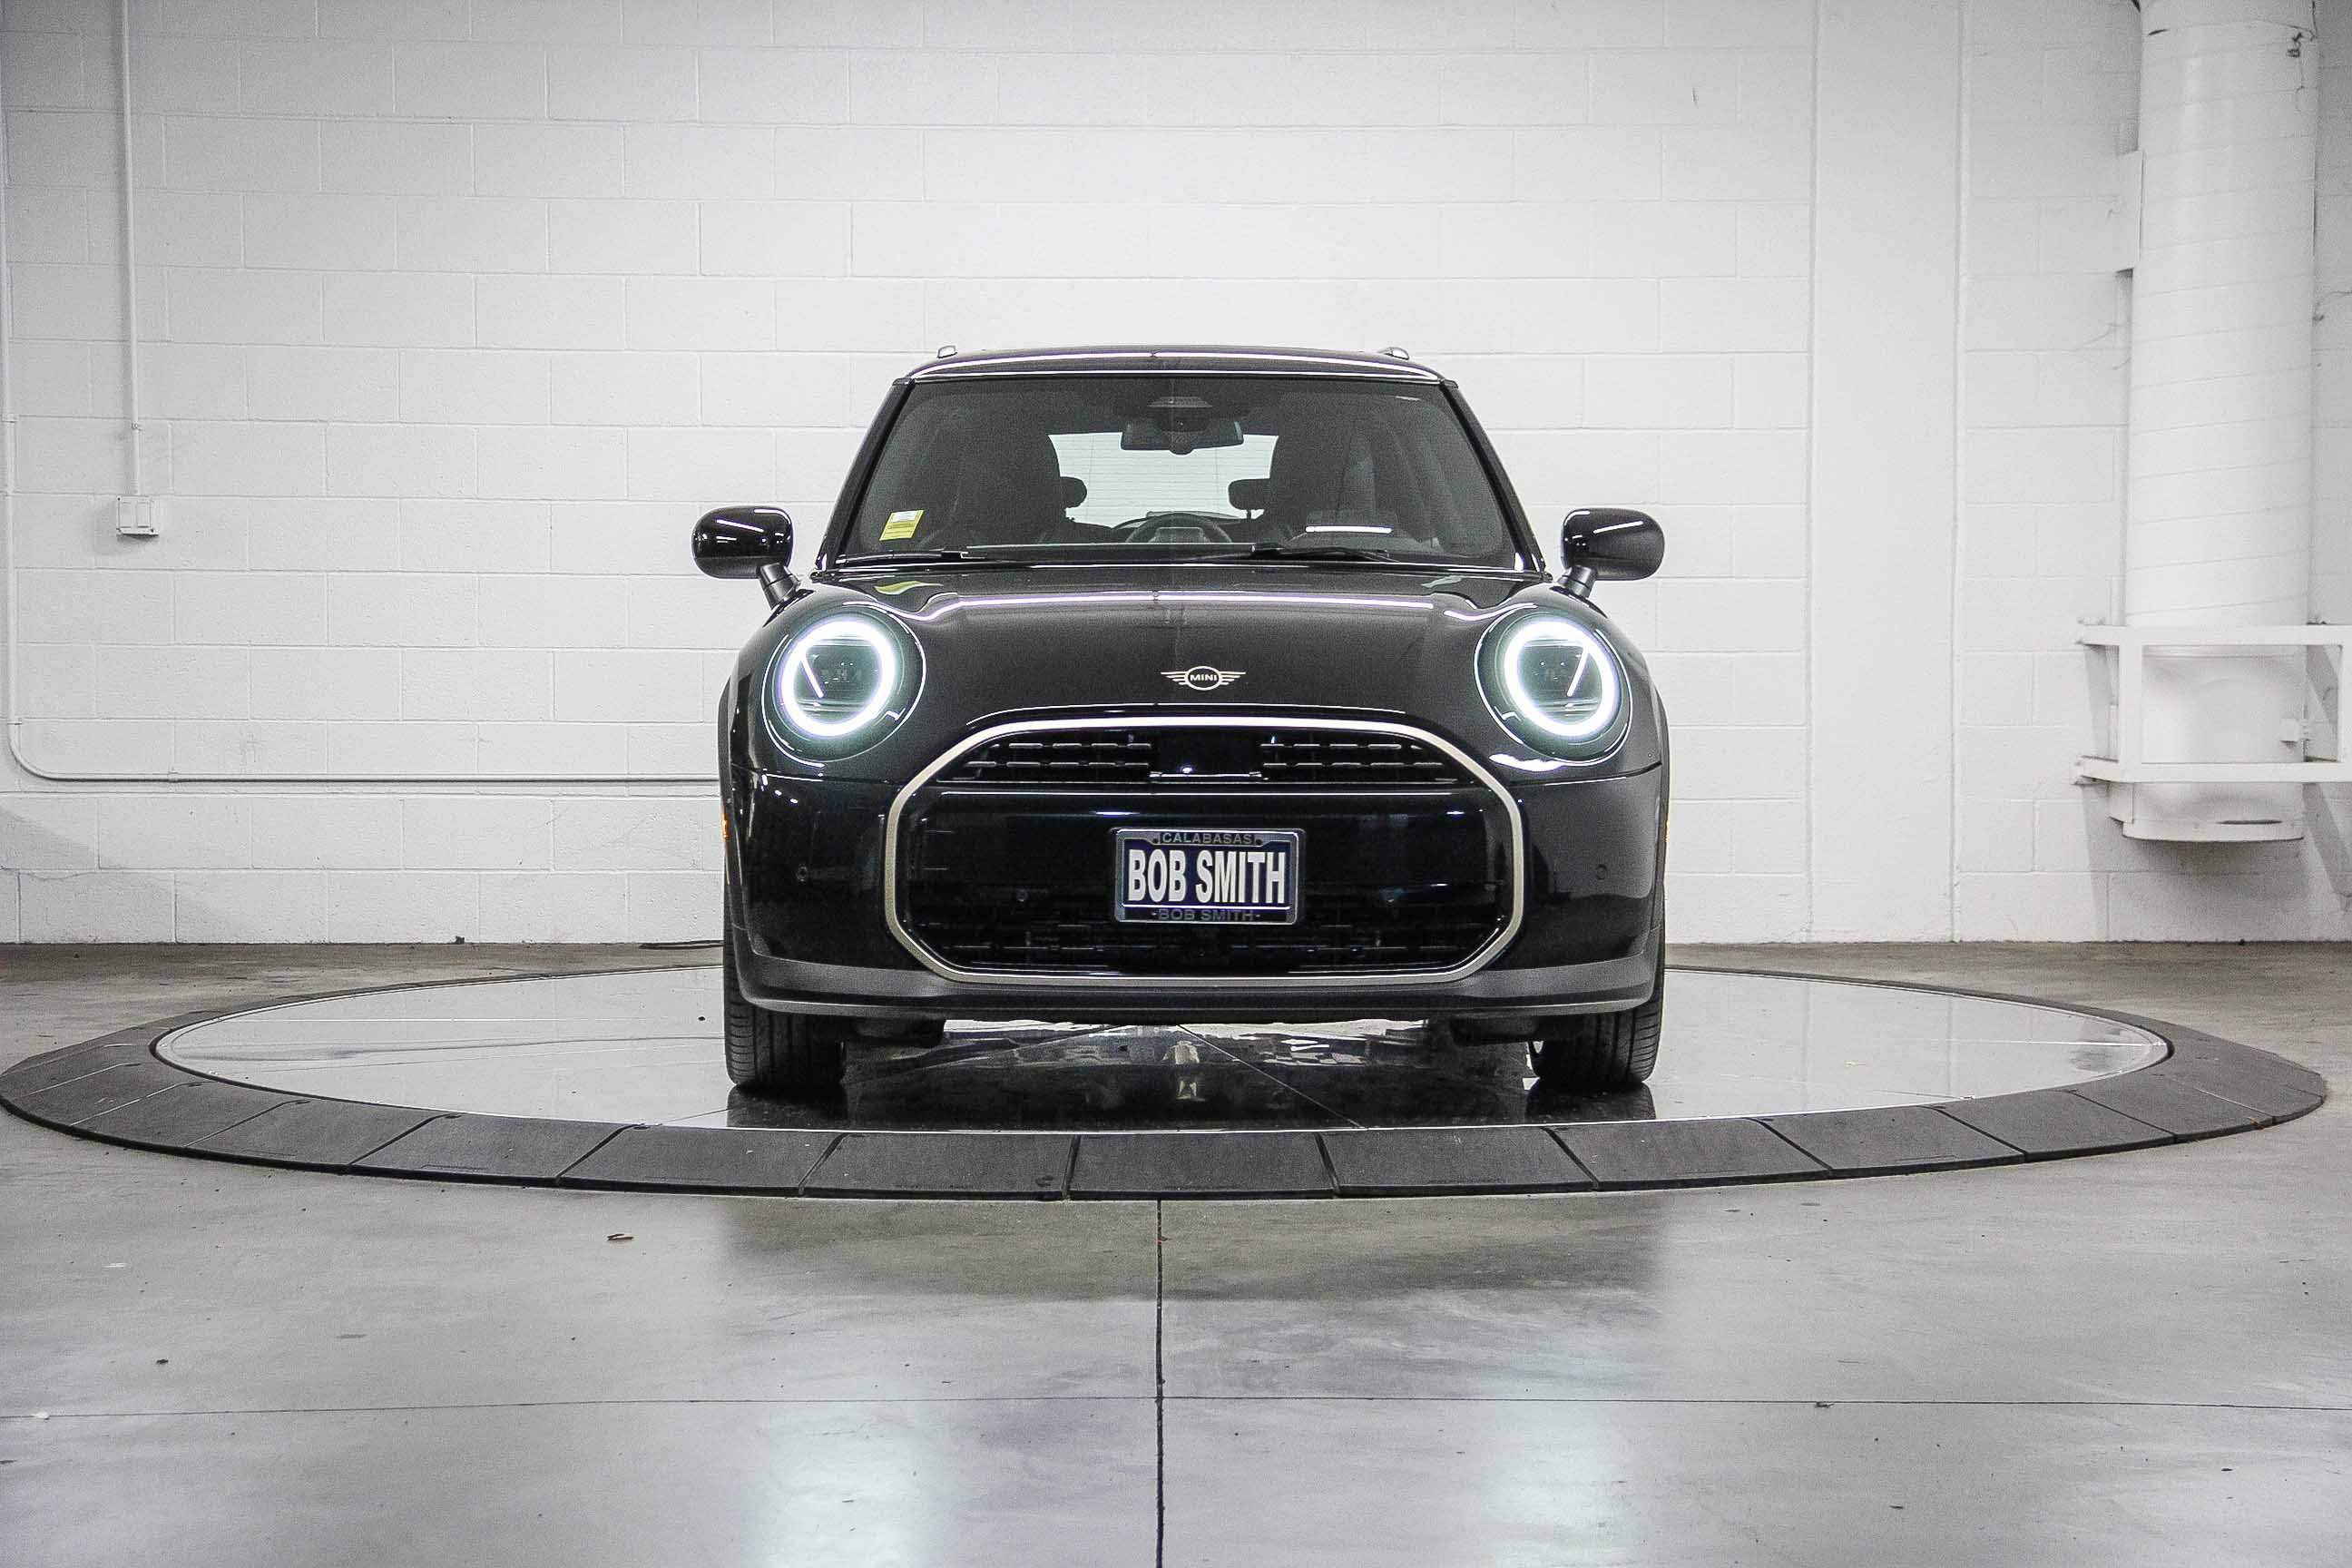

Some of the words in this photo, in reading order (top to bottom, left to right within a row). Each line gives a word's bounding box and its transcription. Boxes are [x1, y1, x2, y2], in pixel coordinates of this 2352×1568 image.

[1190, 673, 1217, 681] MINI
[1162, 832, 1252, 845] CALABASAS
[1128, 848, 1187, 903] BOB
[1195, 849, 1286, 904] SMITH
